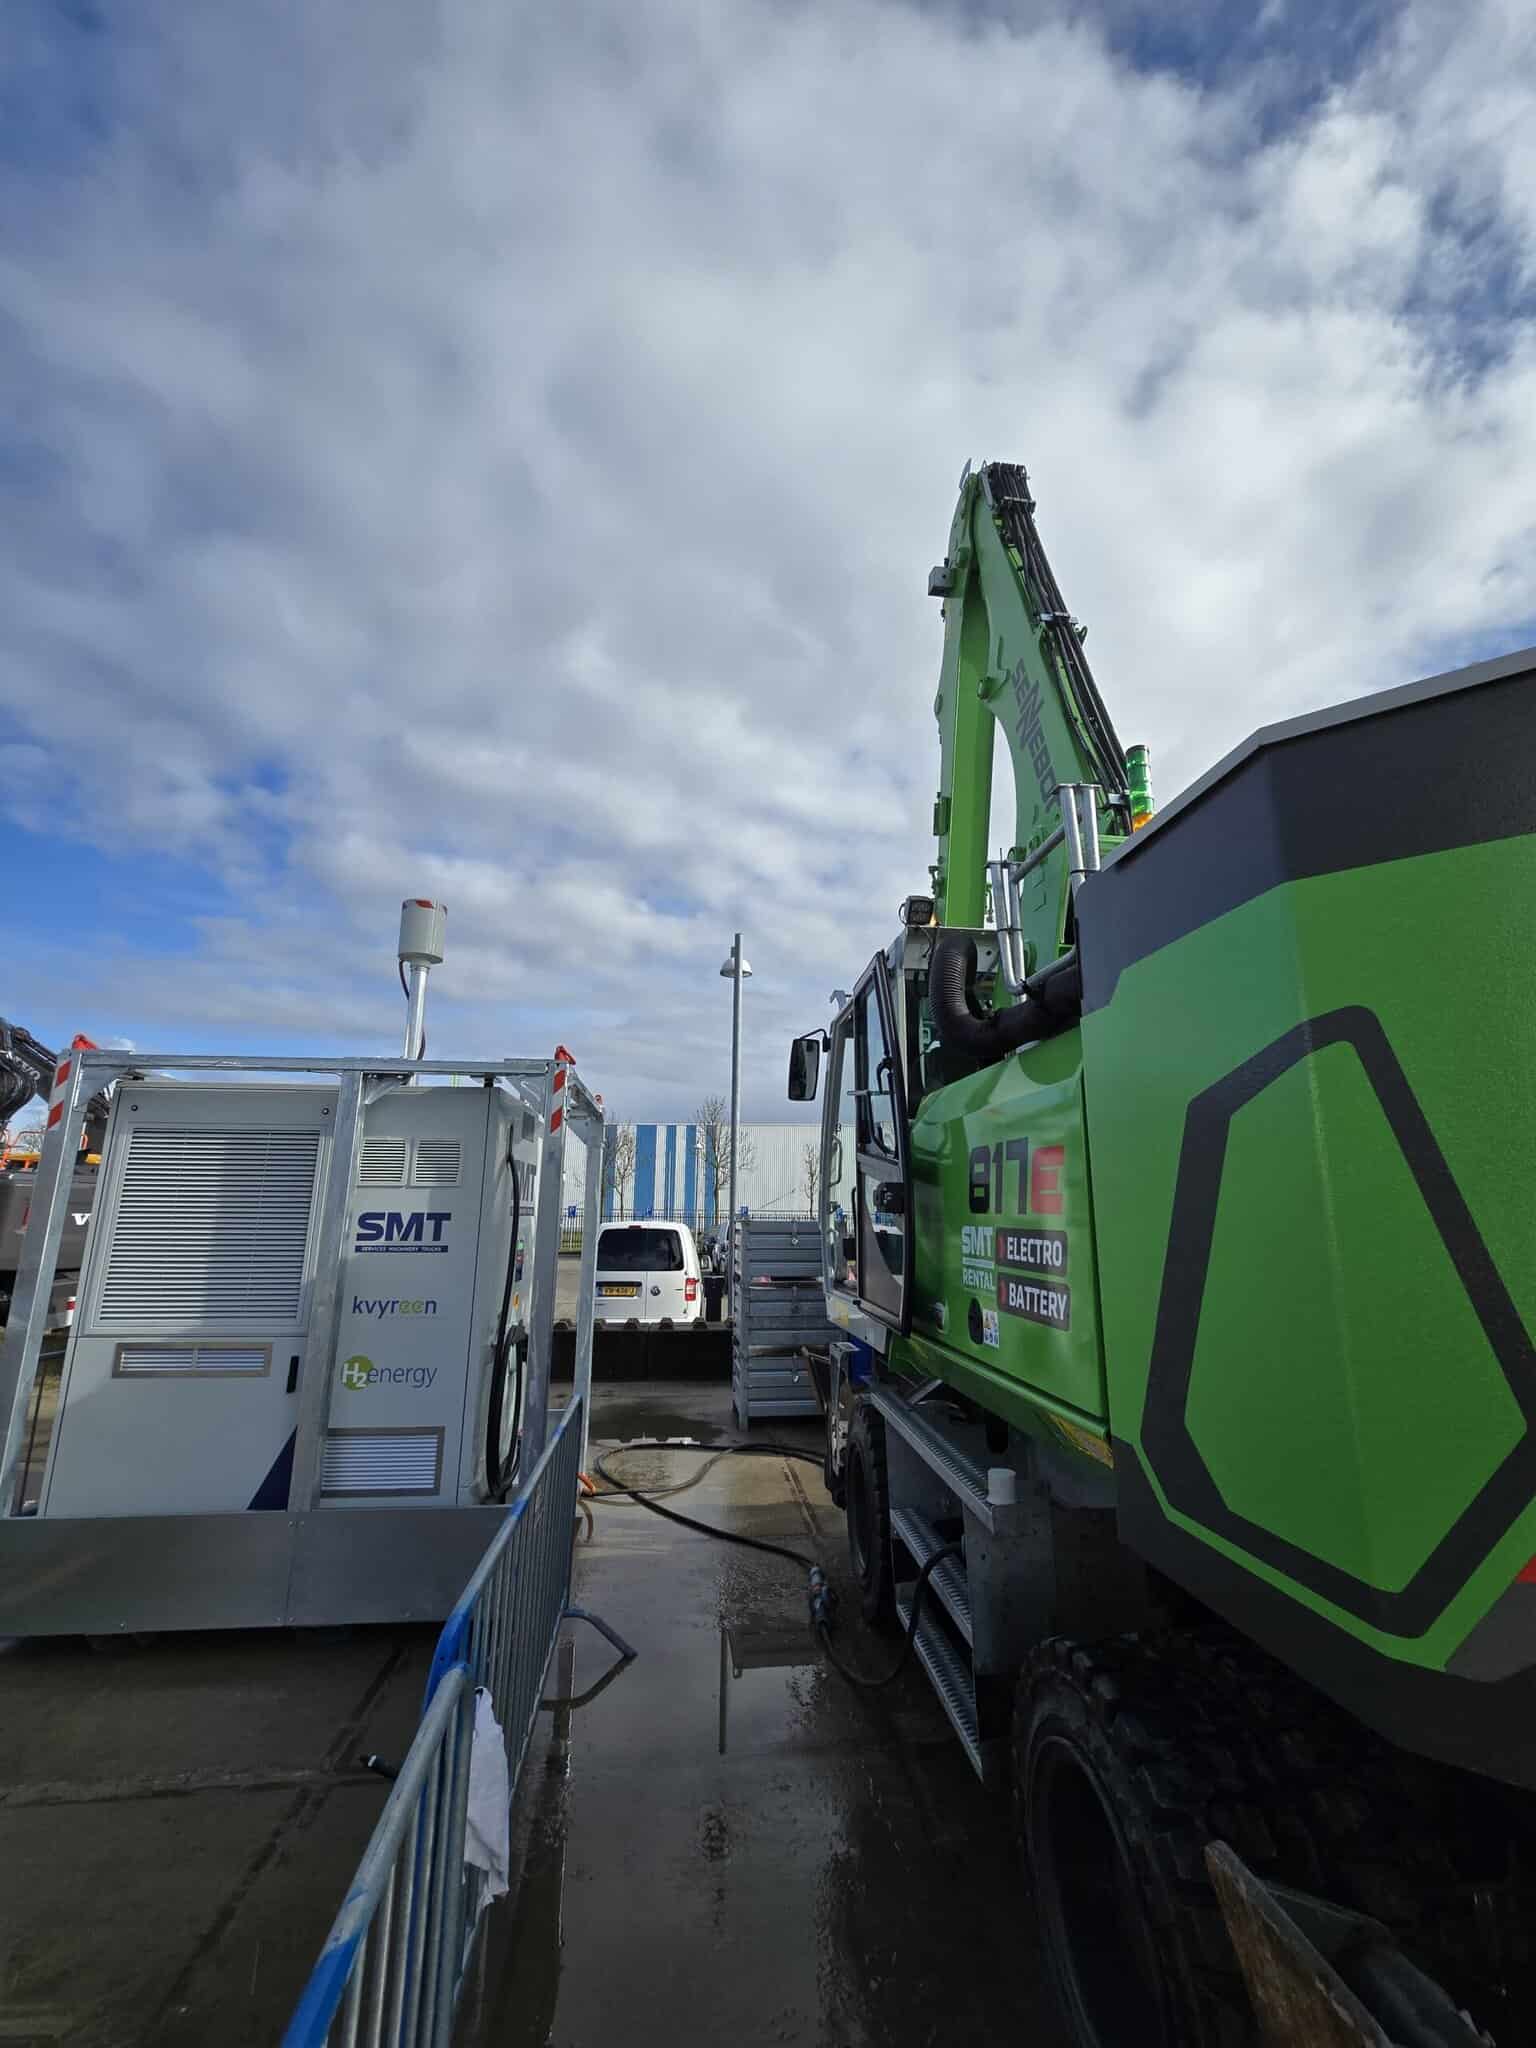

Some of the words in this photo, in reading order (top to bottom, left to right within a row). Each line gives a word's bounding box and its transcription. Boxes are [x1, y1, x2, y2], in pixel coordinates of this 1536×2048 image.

[356, 1212, 451, 1241] SMT
[962, 1226, 993, 1257] SMT
[1007, 1236, 1063, 1267] ELECTRO
[962, 1267, 996, 1290] RENTAL
[352, 1296, 437, 1319] kvyreen
[1008, 1282, 1067, 1321] BATTERY
